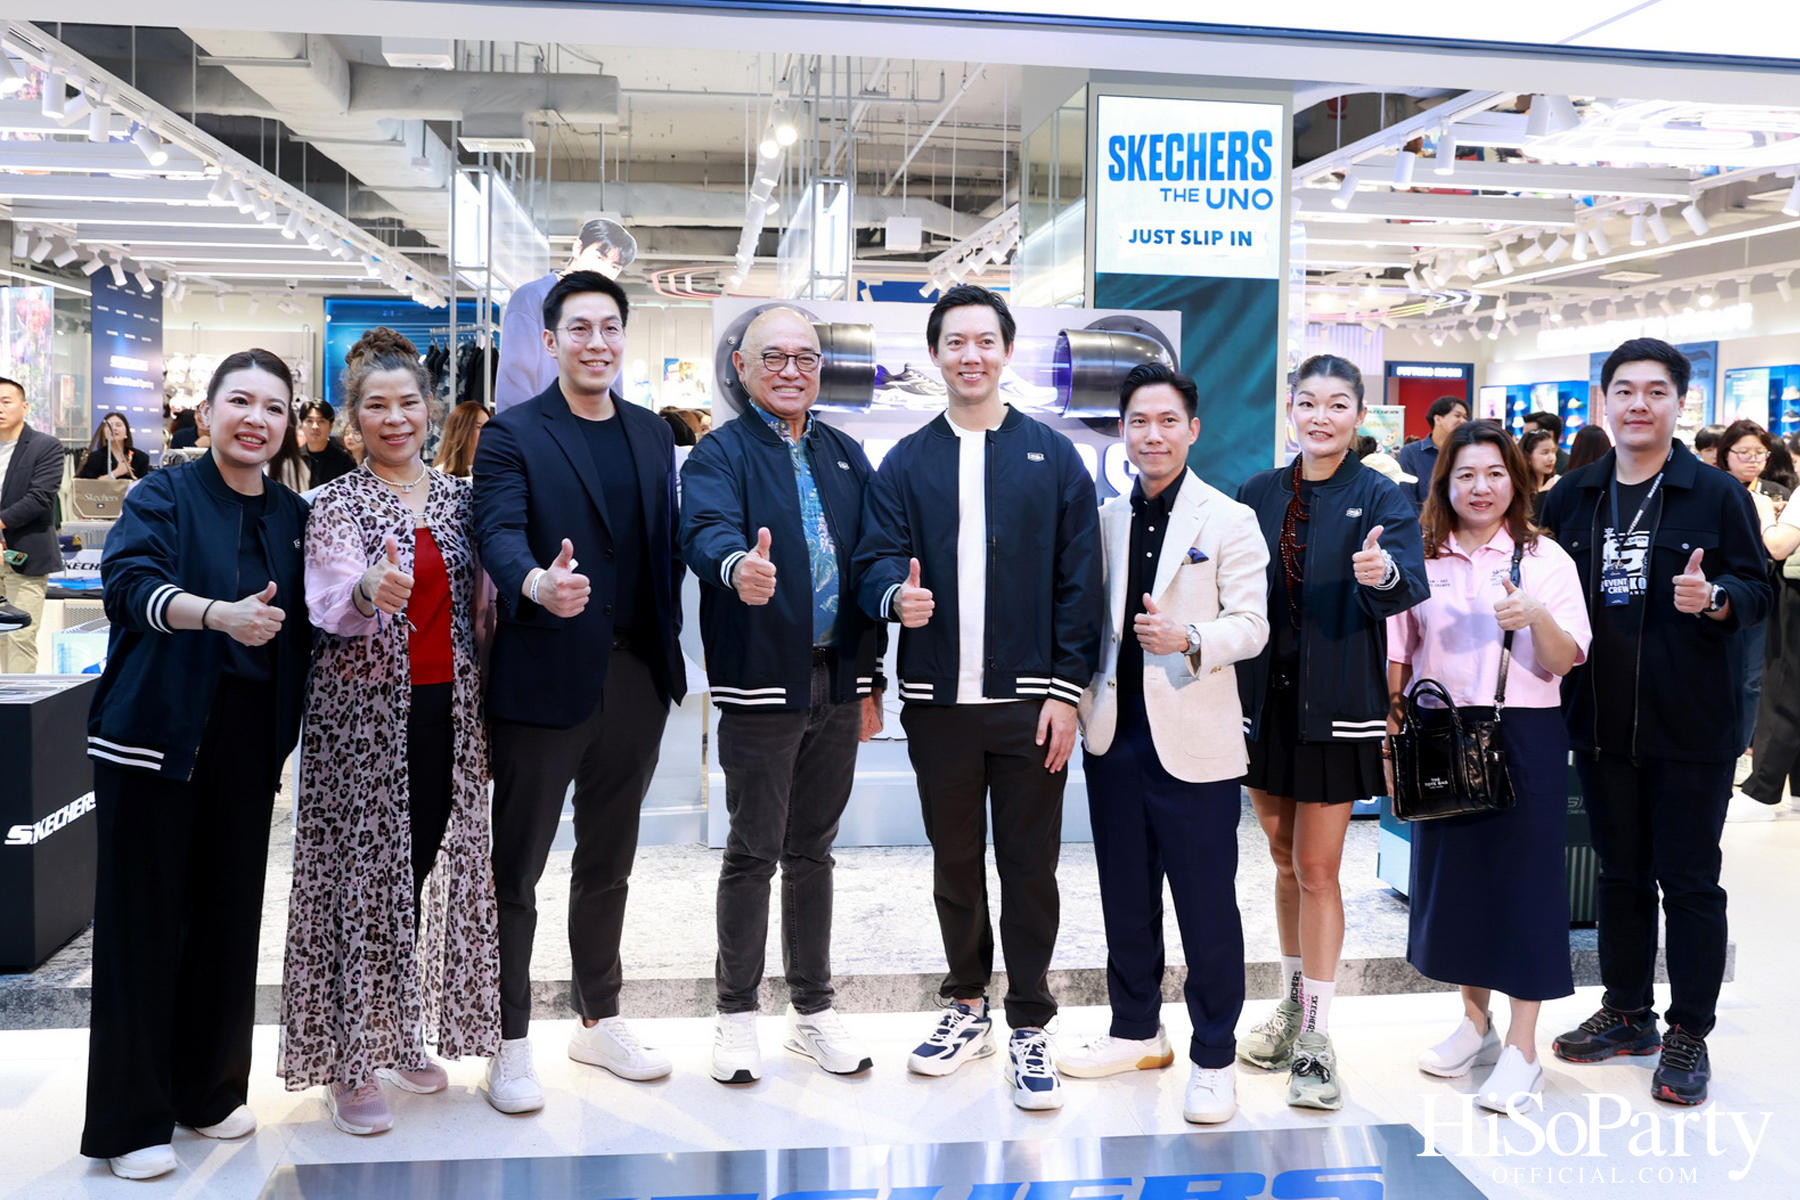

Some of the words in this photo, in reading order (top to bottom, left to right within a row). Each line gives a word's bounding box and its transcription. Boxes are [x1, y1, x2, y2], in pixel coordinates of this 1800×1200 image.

[1108, 130, 1273, 182] SKECHERS
[1160, 188, 1200, 202] THE
[1206, 188, 1274, 211] UNO
[1128, 229, 1176, 245] JUST
[1180, 230, 1224, 246] SLIP
[1230, 231, 1253, 247] IN
[1604, 578, 1628, 587] EVENT
[1608, 586, 1630, 595] CREW
